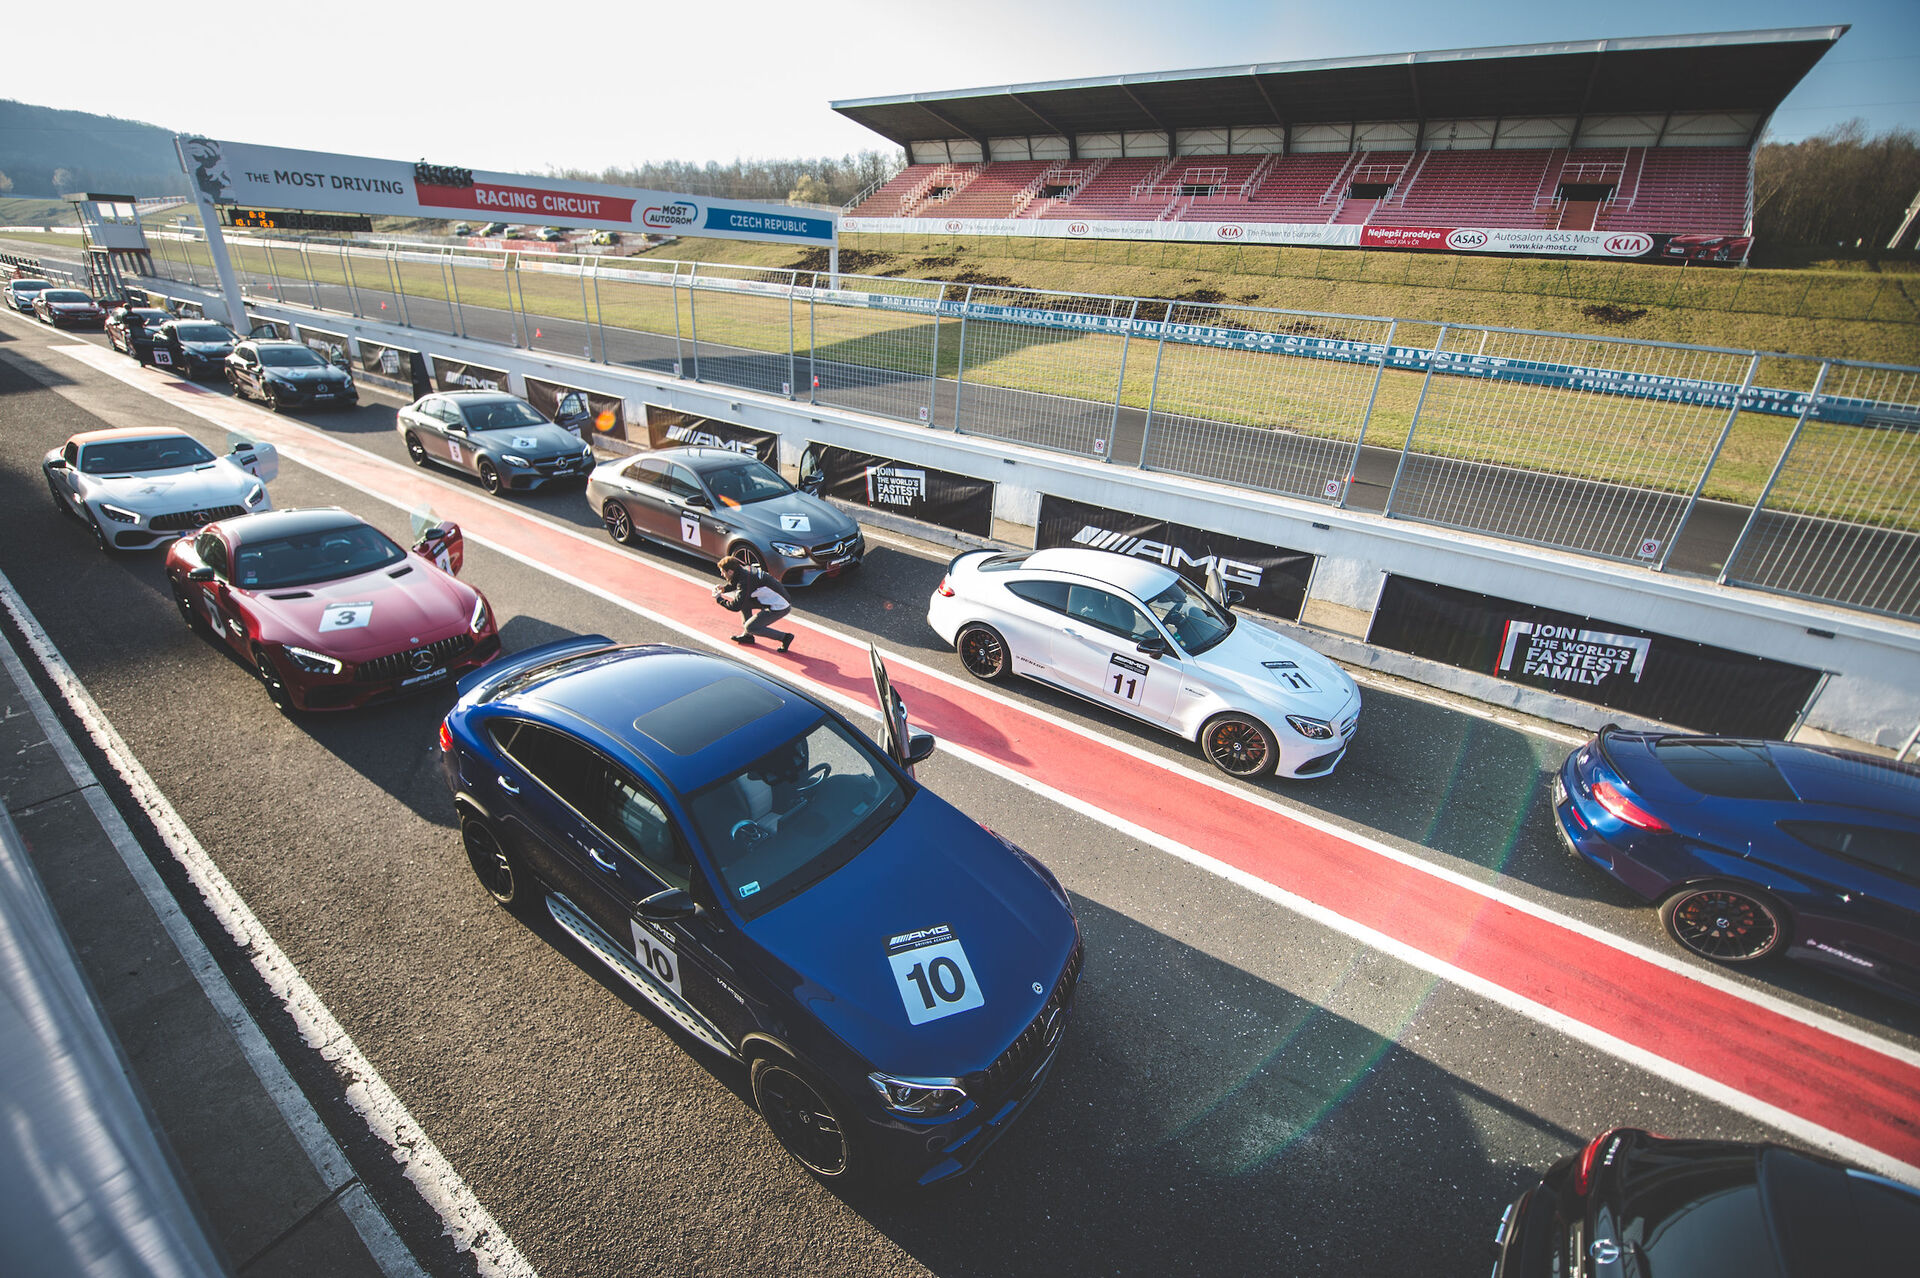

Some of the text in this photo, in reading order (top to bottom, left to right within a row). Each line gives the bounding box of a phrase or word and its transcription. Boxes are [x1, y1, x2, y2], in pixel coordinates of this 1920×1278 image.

[246, 170, 404, 195] THE MOST DRIVING
[475, 189, 601, 215] RACING CIRCUIT
[662, 205, 687, 216] MOST
[650, 215, 692, 225] AUTODROM
[729, 214, 808, 233] CZECH REPUBLIC
[1071, 225, 1086, 233] KIA
[1221, 227, 1240, 237] KIA
[1261, 230, 1283, 238] Power
[1293, 231, 1322, 239] Surprise
[1368, 229, 1441, 240] Nejlepší prodejce
[1453, 234, 1482, 245] ASAS
[1493, 233, 1600, 244] Autosalon ASAS Most
[1611, 238, 1642, 251] KIA
[1509, 242, 1577, 251] www.kia-most.cz
[1243, 333, 1274, 349] CO
[158, 353, 169, 362] 18
[463, 374, 498, 391] AMG
[692, 431, 757, 459] AMG
[877, 468, 894, 476] JOIN
[891, 478, 918, 486] WORLD'S
[877, 484, 918, 497] FASTEST
[878, 495, 912, 506] FAMILY
[788, 518, 801, 528] 7
[687, 524, 694, 539] 7
[1126, 539, 1264, 587] AMG
[335, 611, 356, 625] 3
[1532, 623, 1577, 640] JOIN
[1531, 637, 1631, 660] THE WORLD'S
[1526, 647, 1628, 674] FASTEST
[1281, 672, 1312, 688] 11
[1522, 661, 1608, 686] FAMILY
[1113, 673, 1137, 700] 11
[649, 921, 676, 943] AMG
[908, 924, 950, 941] AMG
[638, 938, 674, 983] 10
[905, 956, 966, 1010] 10
